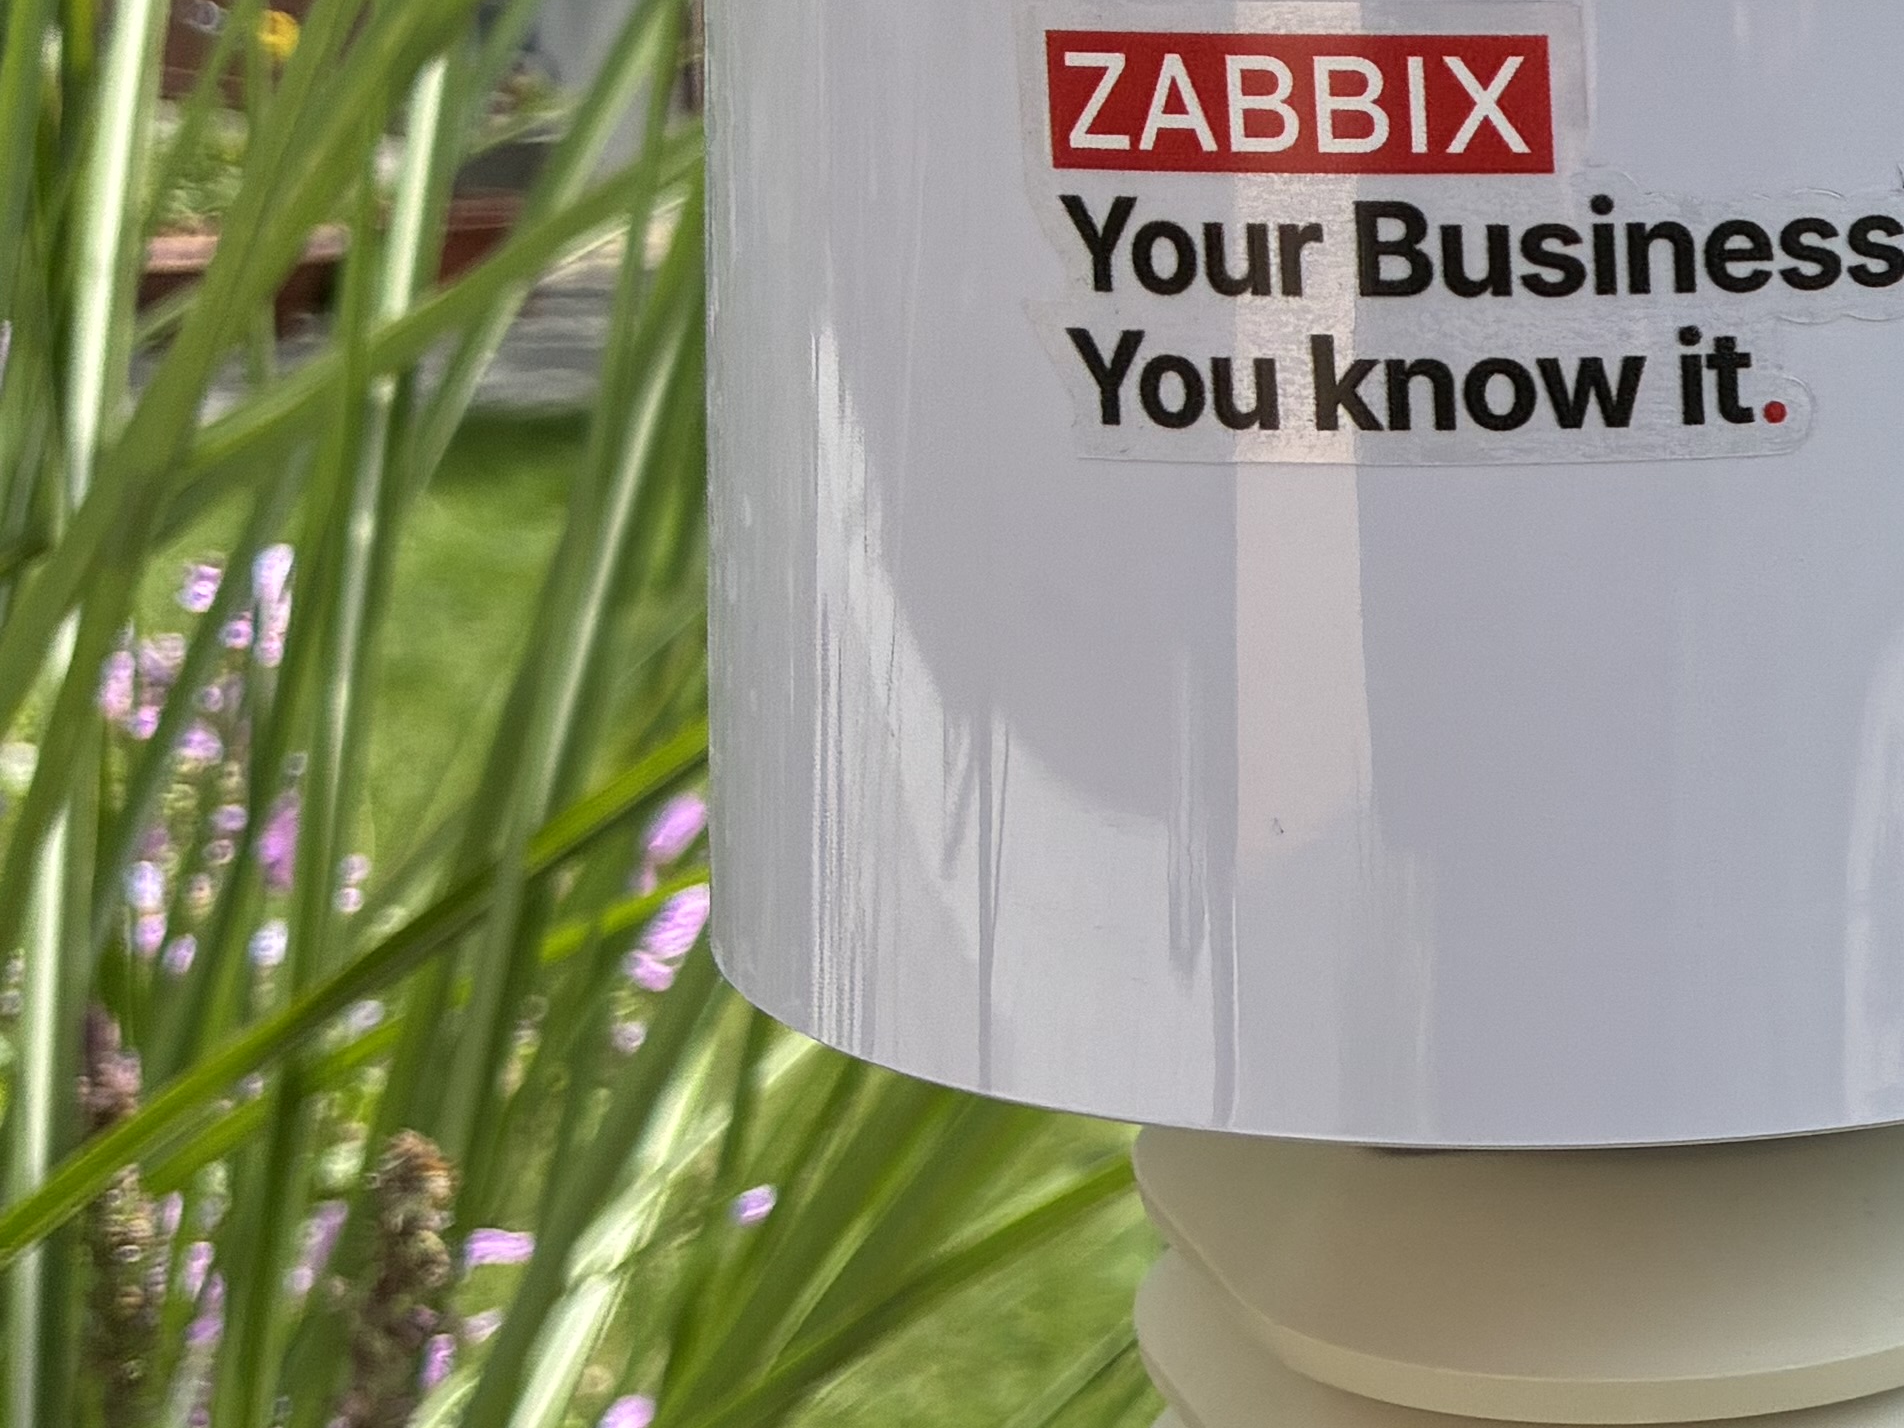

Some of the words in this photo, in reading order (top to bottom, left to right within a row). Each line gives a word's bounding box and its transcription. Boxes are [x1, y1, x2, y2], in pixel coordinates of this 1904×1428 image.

[1065, 52, 1531, 154] ZABBIX
[1058, 194, 1324, 298] Your
[1065, 327, 1281, 431] You
[1310, 334, 1648, 432] know
[1677, 325, 1788, 426] it.
